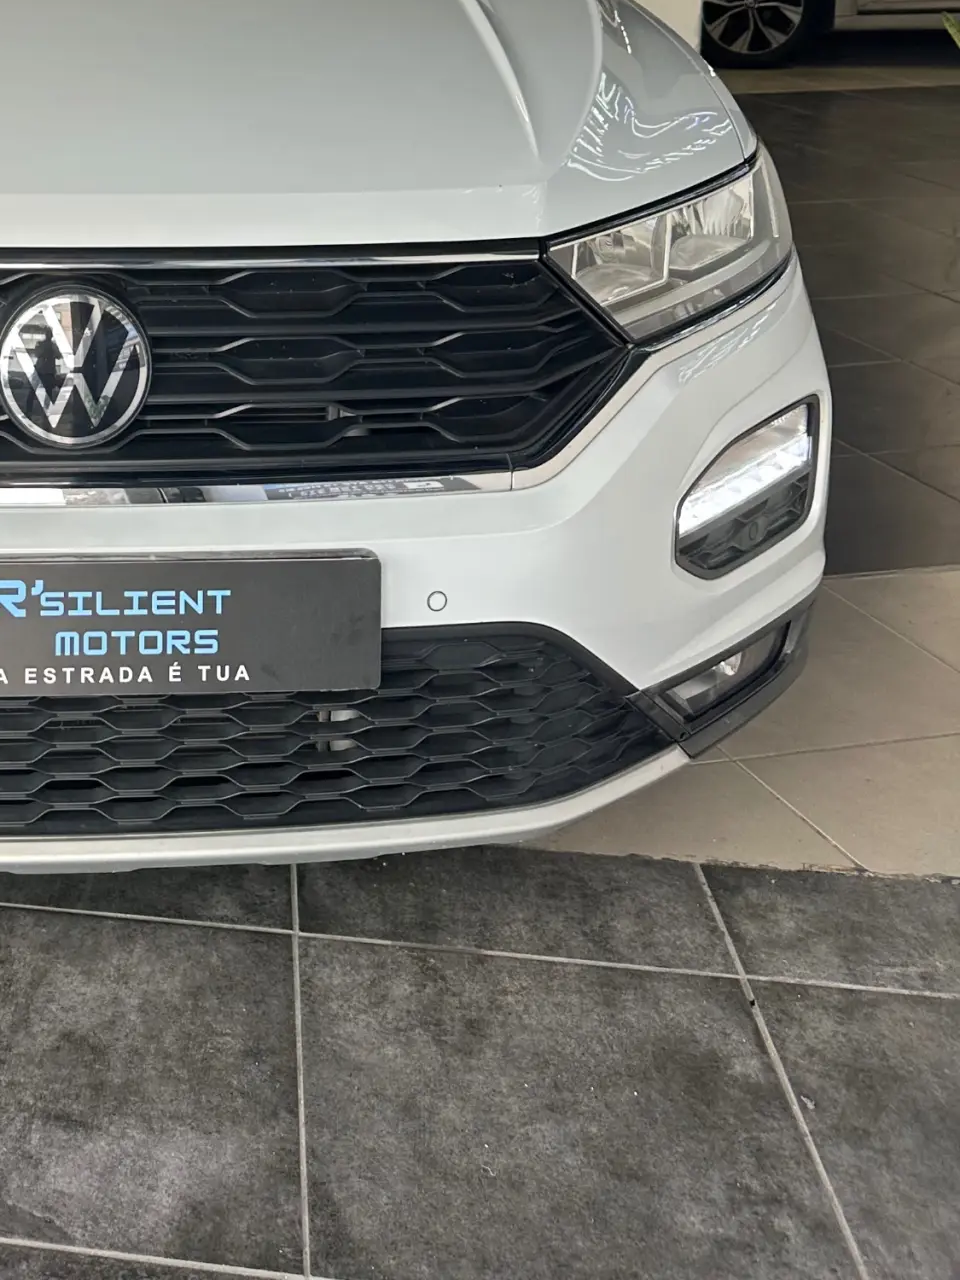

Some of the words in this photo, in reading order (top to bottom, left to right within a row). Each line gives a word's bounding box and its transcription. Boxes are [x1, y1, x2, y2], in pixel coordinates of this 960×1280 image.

[55, 629, 219, 656] MOTORS
[25, 666, 153, 684] ESTRADA
[168, 661, 182, 682] É
[198, 665, 250, 682] TUA
